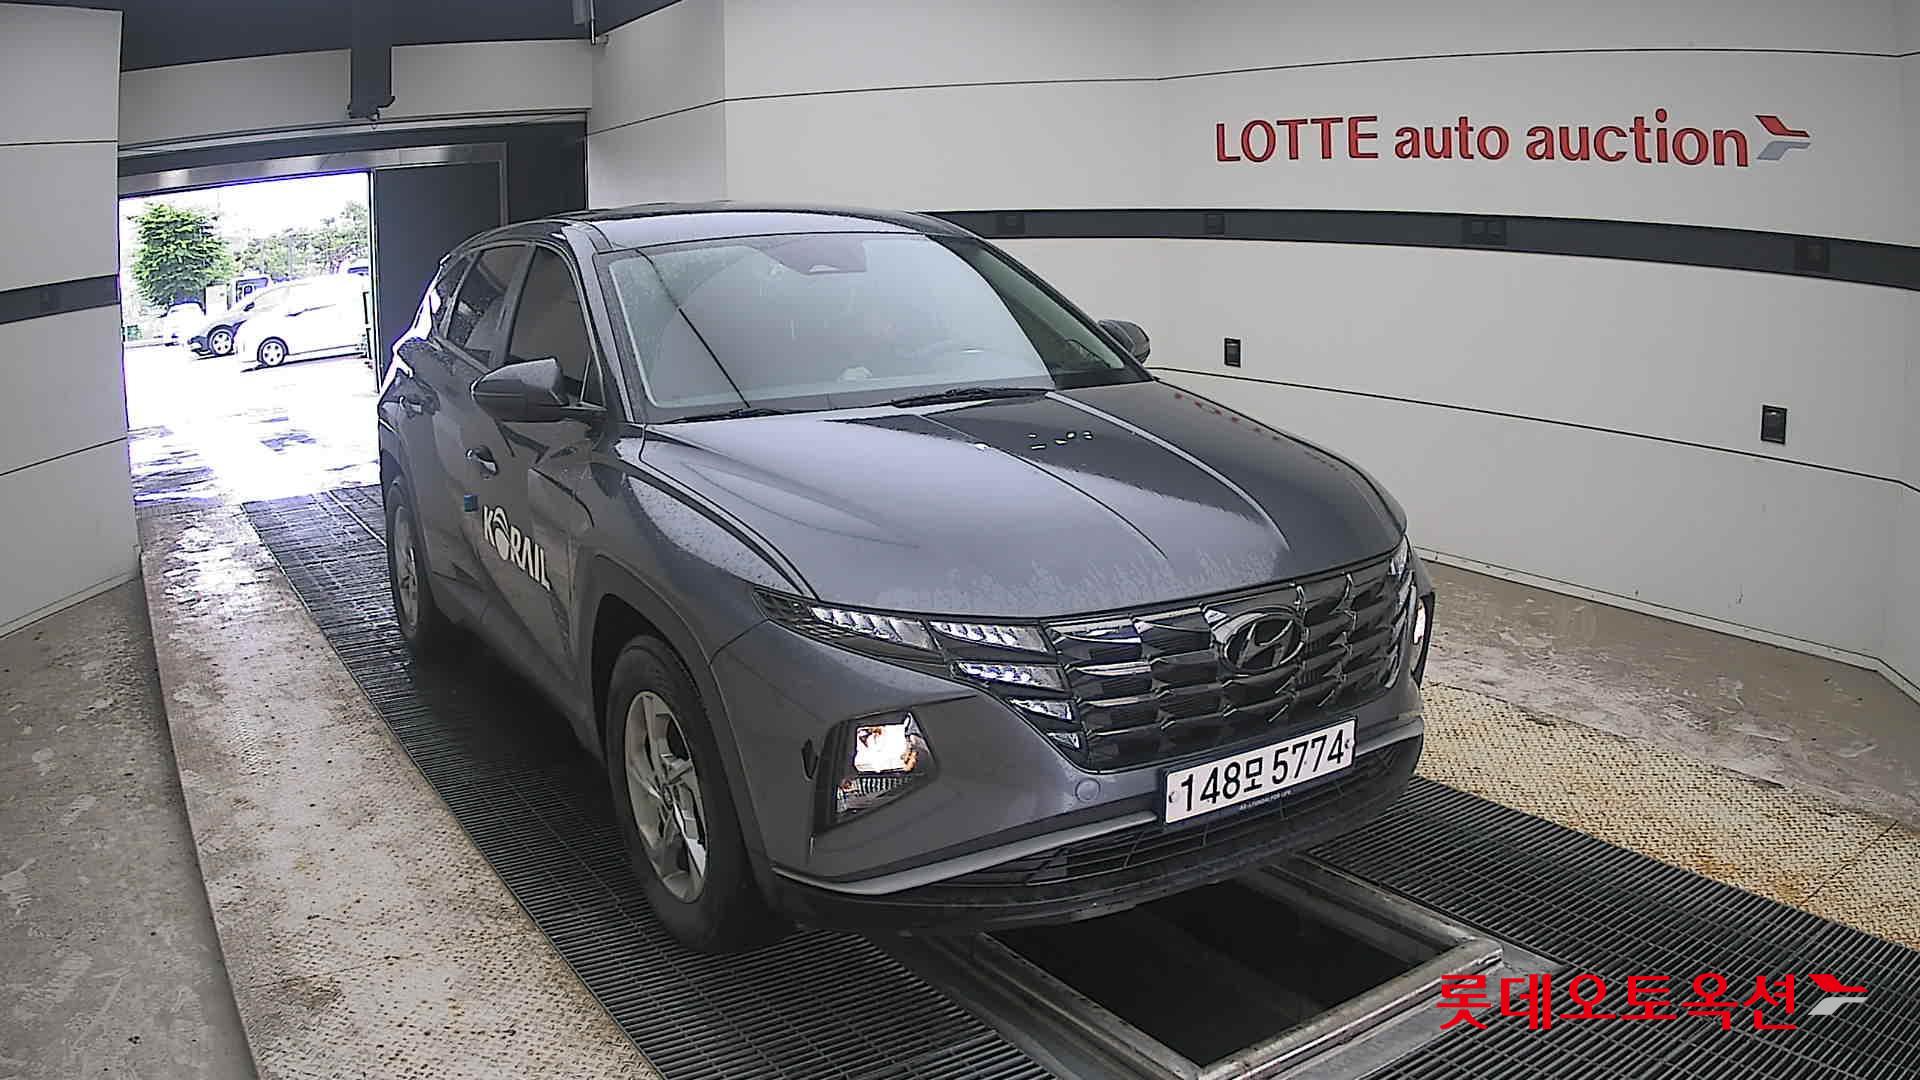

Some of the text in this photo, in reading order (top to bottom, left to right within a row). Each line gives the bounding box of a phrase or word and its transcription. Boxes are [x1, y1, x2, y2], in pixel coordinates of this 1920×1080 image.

[1216, 108, 1748, 167] LOTTE auto auction
[483, 505, 551, 591] KORAIL
[1181, 729, 1344, 811] 148모 5774
